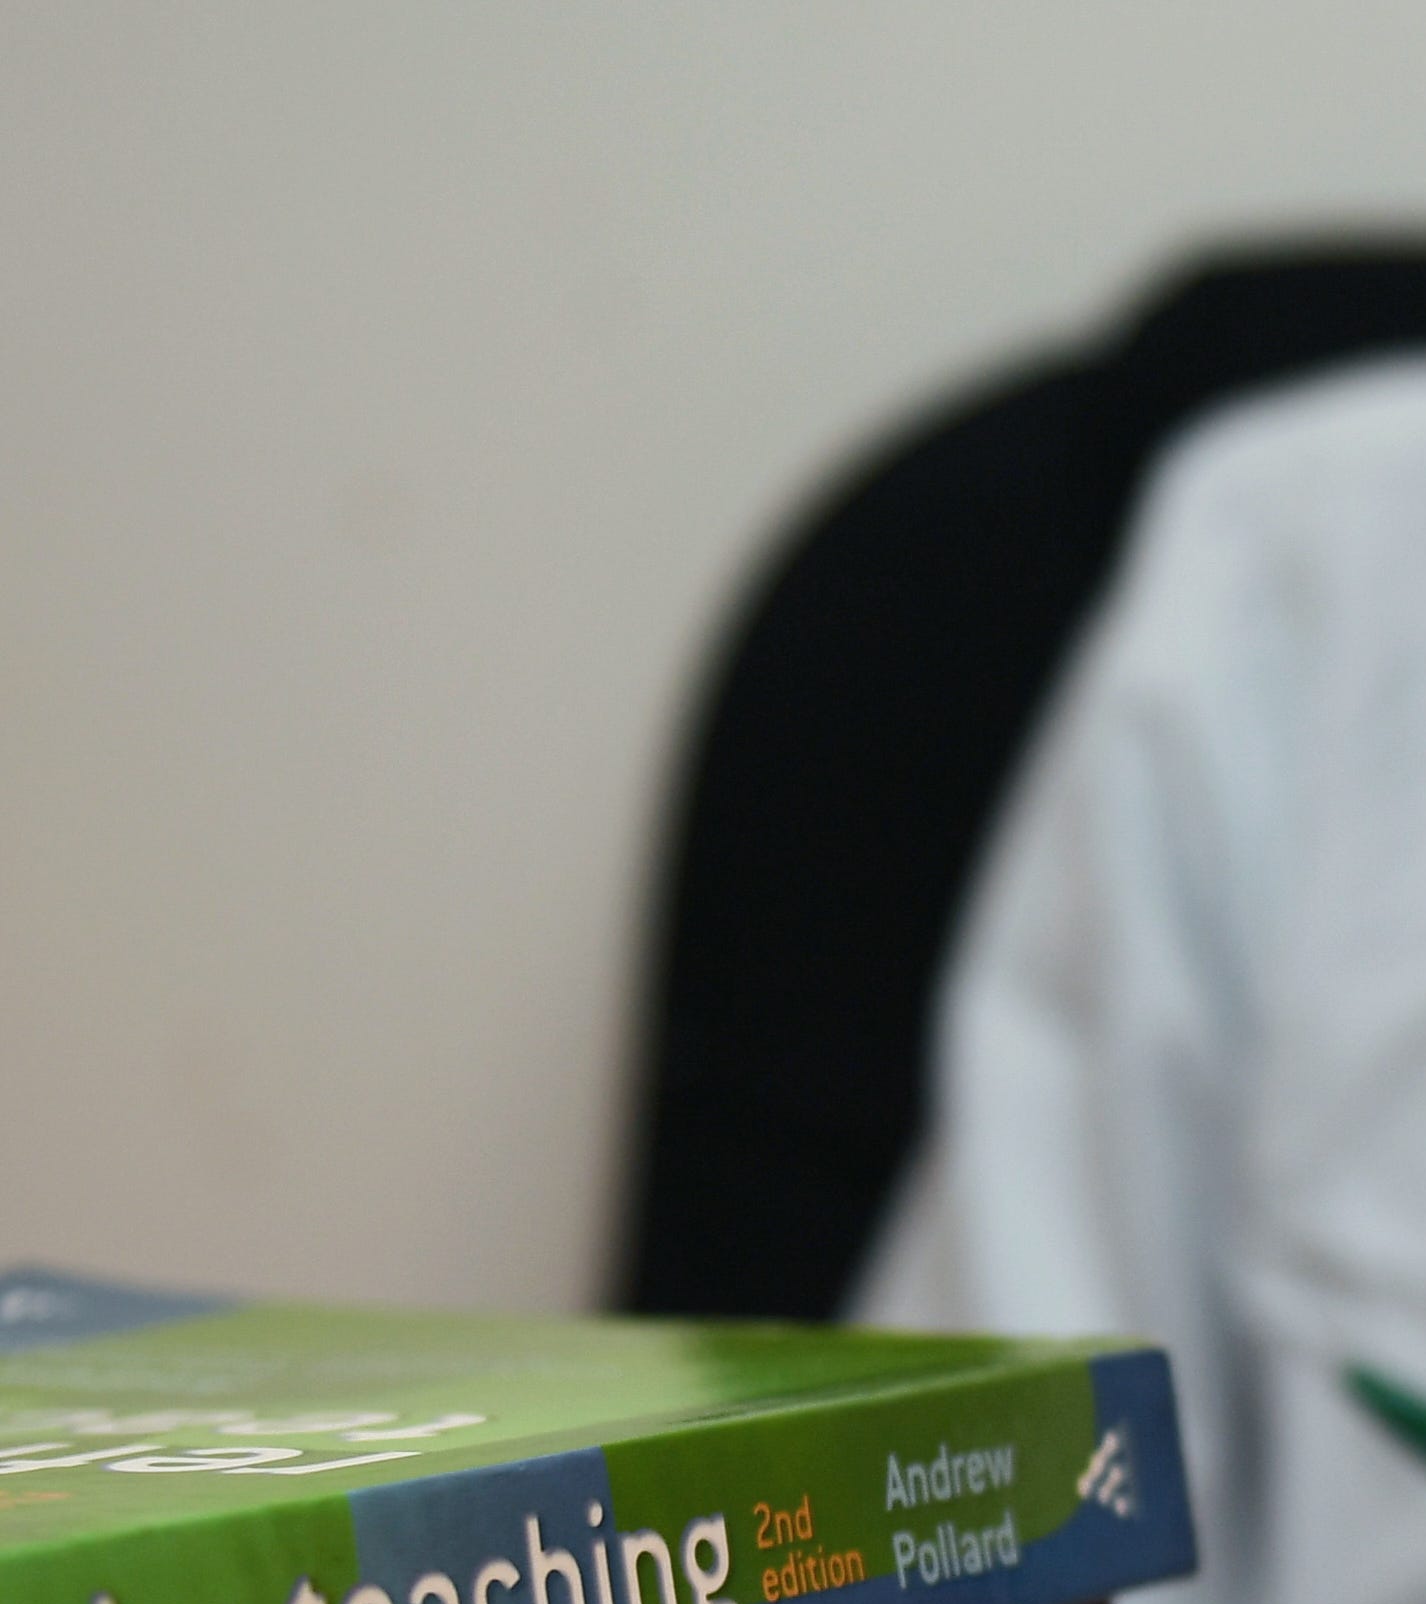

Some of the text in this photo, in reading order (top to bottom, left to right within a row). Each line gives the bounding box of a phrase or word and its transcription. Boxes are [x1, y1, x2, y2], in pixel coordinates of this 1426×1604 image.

[885, 1437, 1018, 1510] Andrew
[754, 1496, 812, 1550] 2nd
[895, 1517, 1021, 1590] Pollard
[762, 1545, 866, 1603] edition
